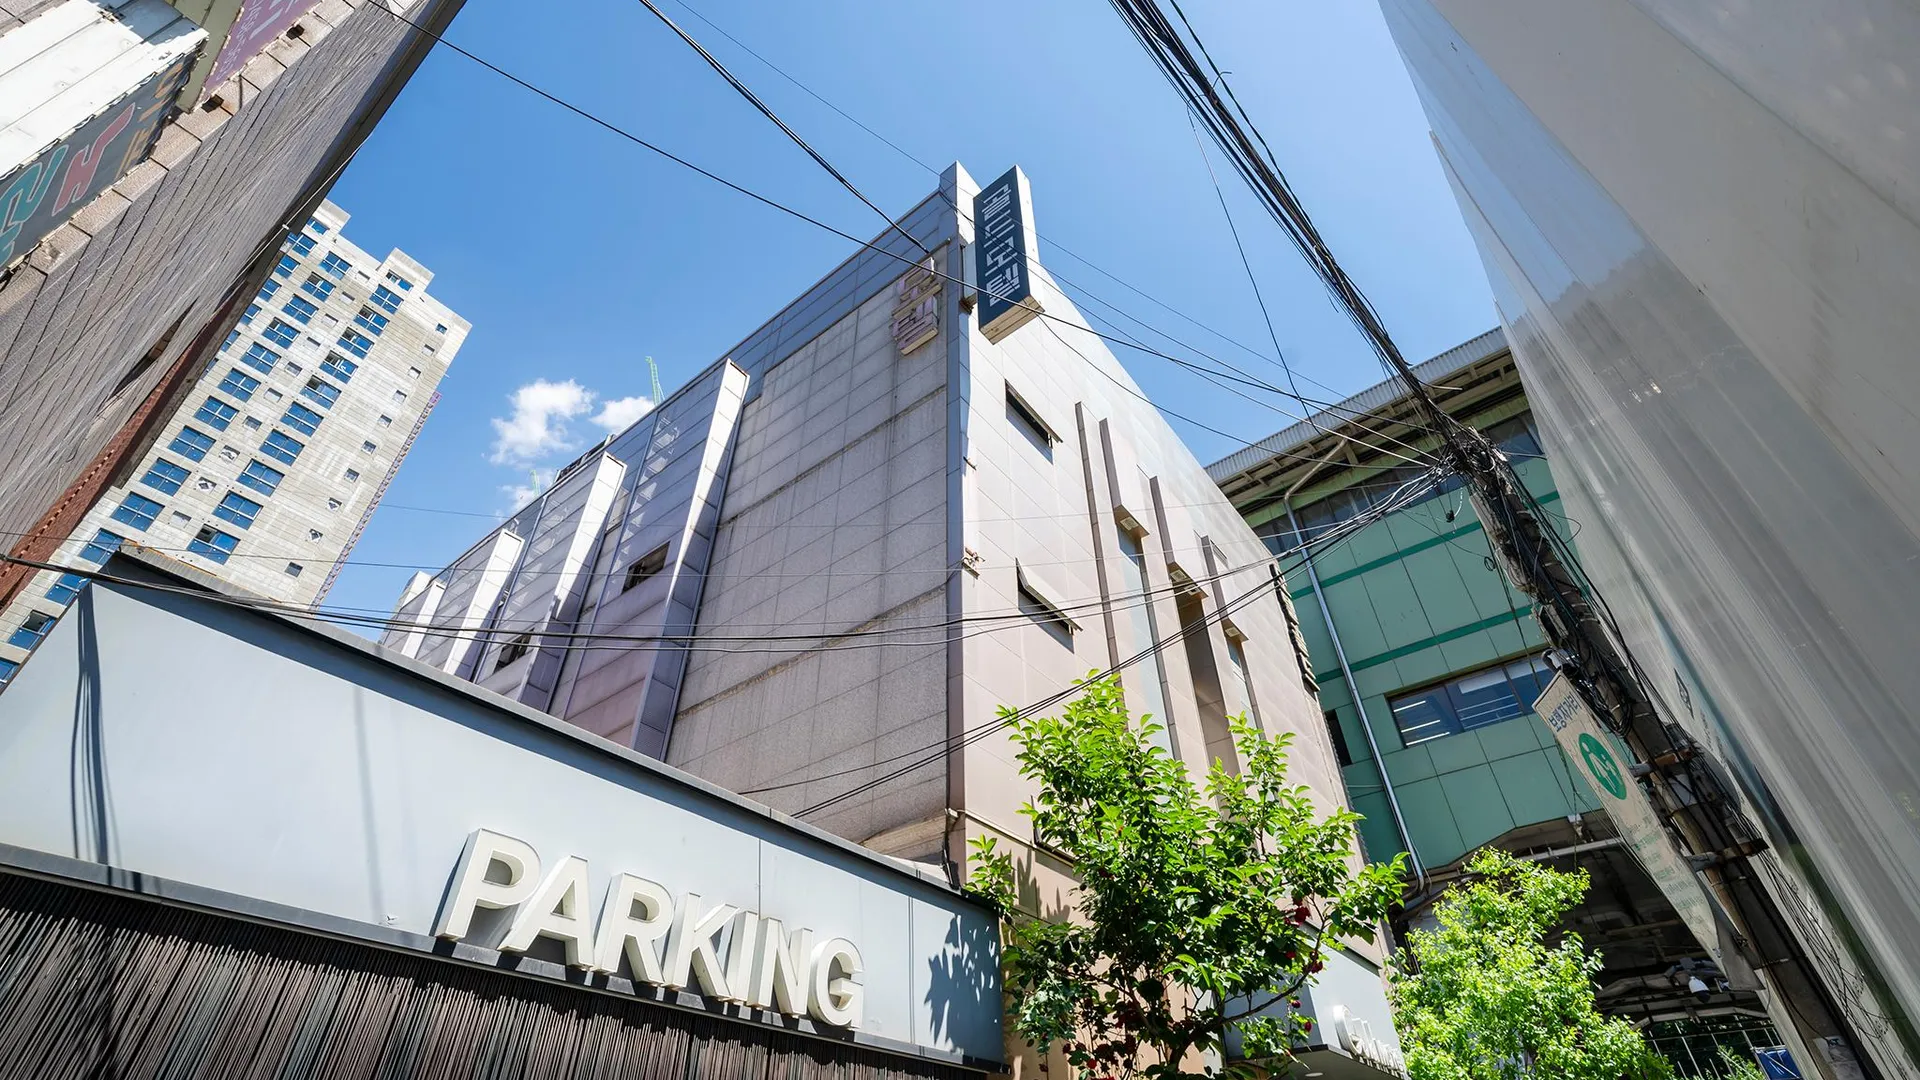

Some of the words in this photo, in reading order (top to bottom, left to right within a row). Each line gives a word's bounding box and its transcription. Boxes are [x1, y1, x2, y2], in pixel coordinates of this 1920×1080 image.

[981, 183, 1021, 307] 골드모텔
[1548, 691, 1582, 732] 보행자거리
[435, 828, 865, 1030] PARKING
